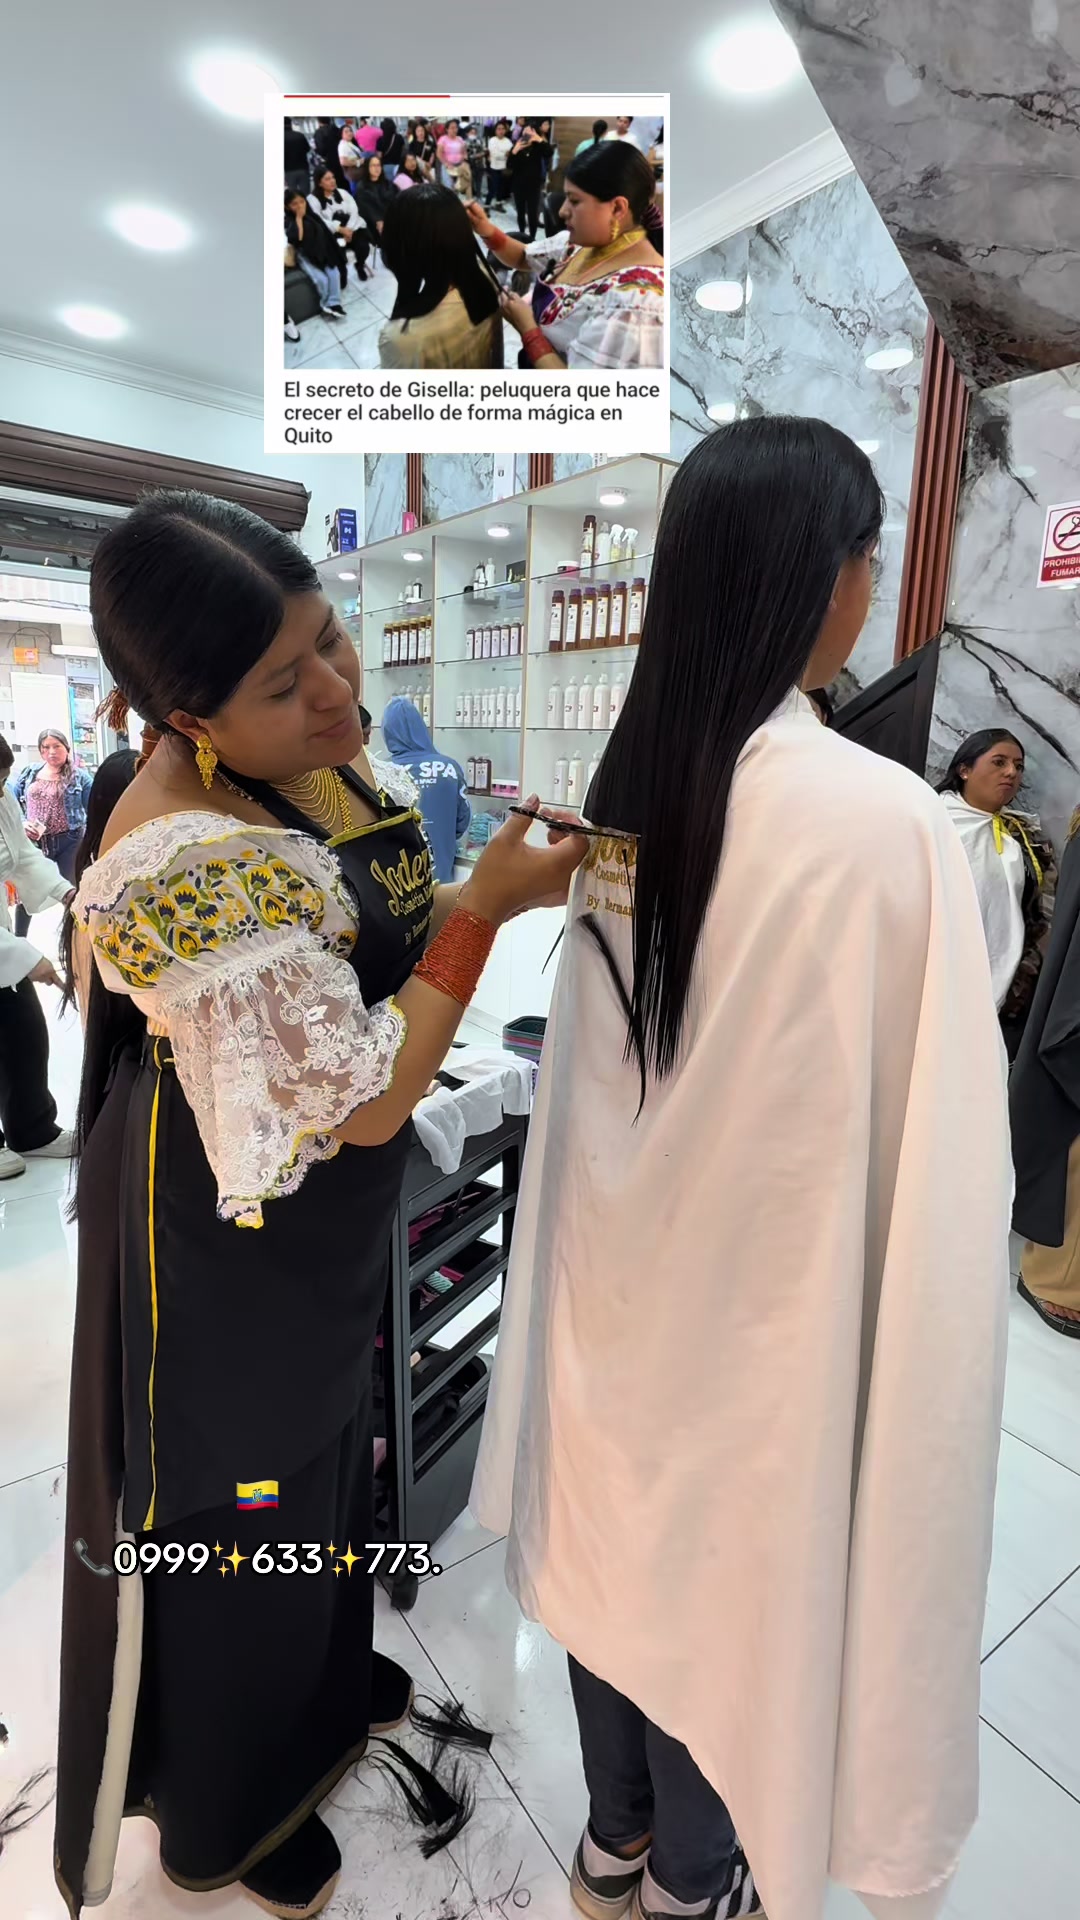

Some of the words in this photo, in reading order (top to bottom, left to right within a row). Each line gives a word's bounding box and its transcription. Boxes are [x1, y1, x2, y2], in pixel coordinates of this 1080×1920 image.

[1043, 556, 1080, 568] PROHIBI
[419, 761, 458, 779] SPA
[586, 894, 600, 910] By
